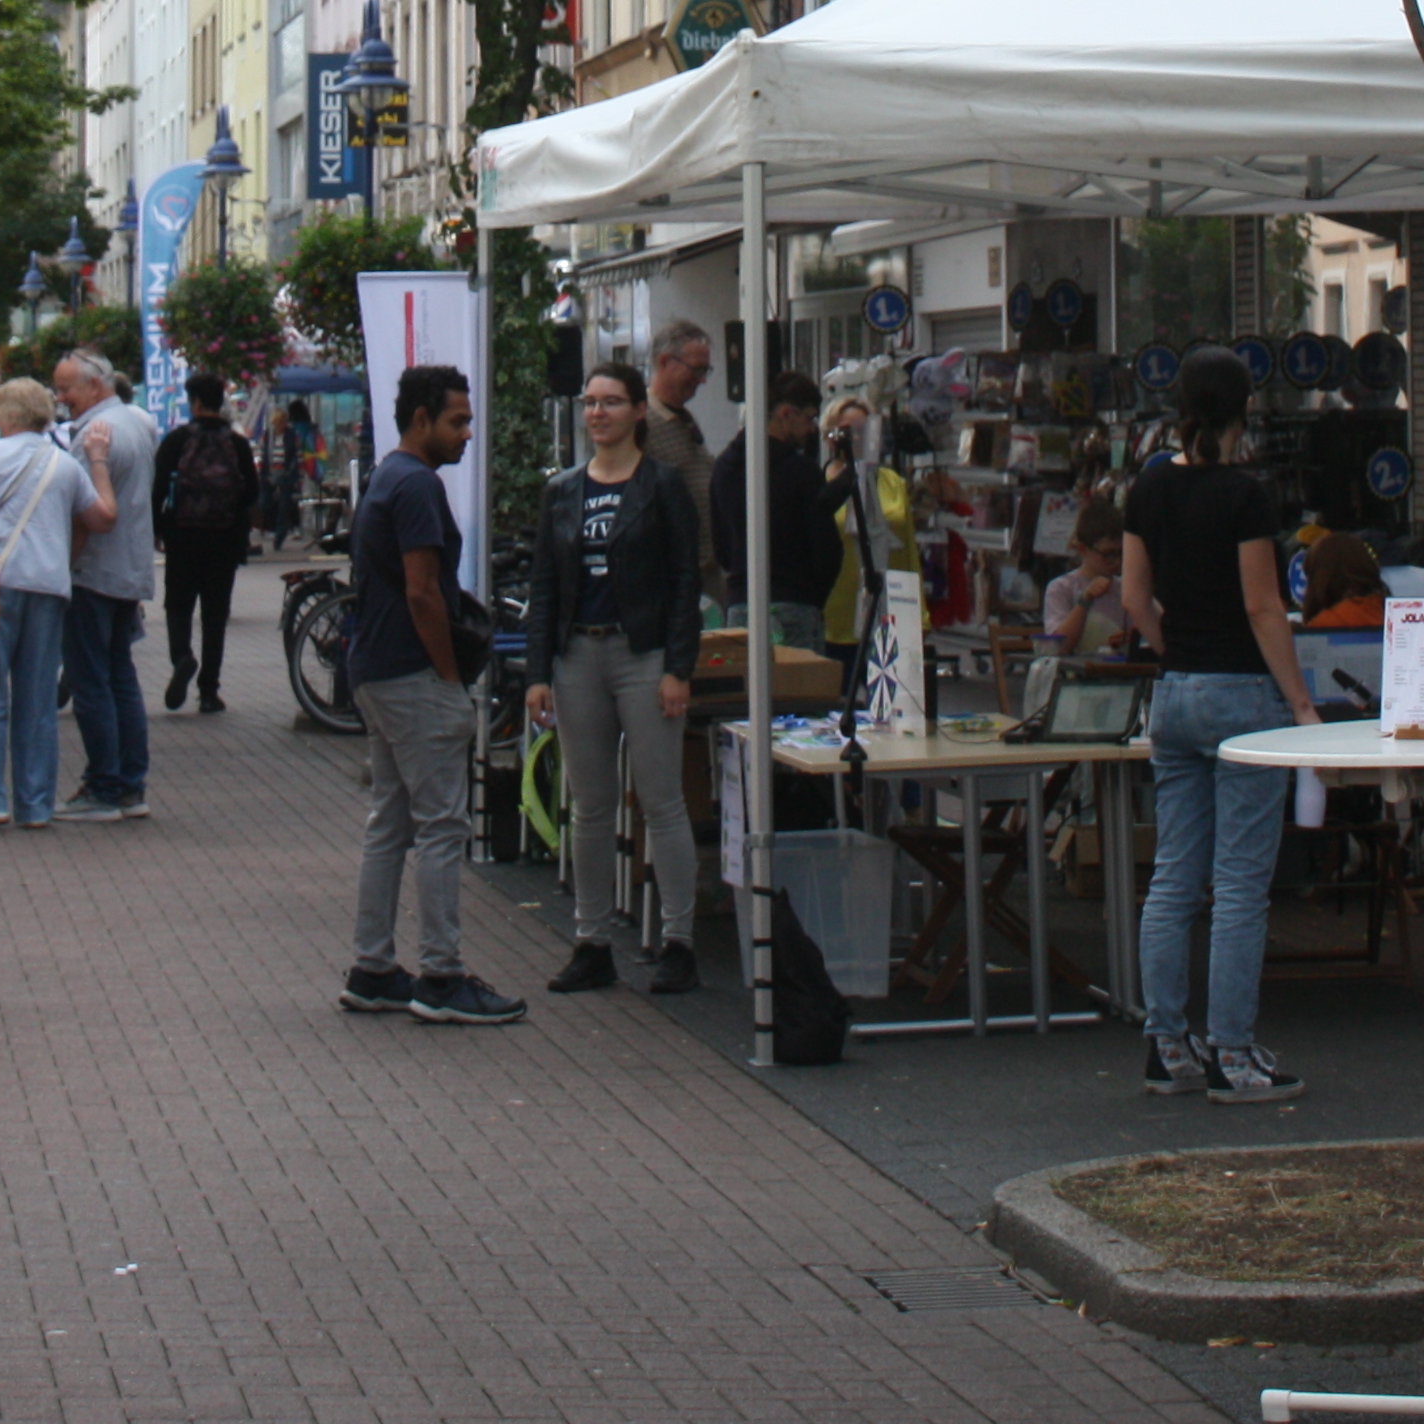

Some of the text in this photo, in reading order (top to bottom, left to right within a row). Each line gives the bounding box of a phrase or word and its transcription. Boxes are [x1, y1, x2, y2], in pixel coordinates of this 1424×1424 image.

[680, 29, 738, 51] Diebe
[319, 69, 342, 184] KIESER
[147, 262, 170, 436] PREMIUM
